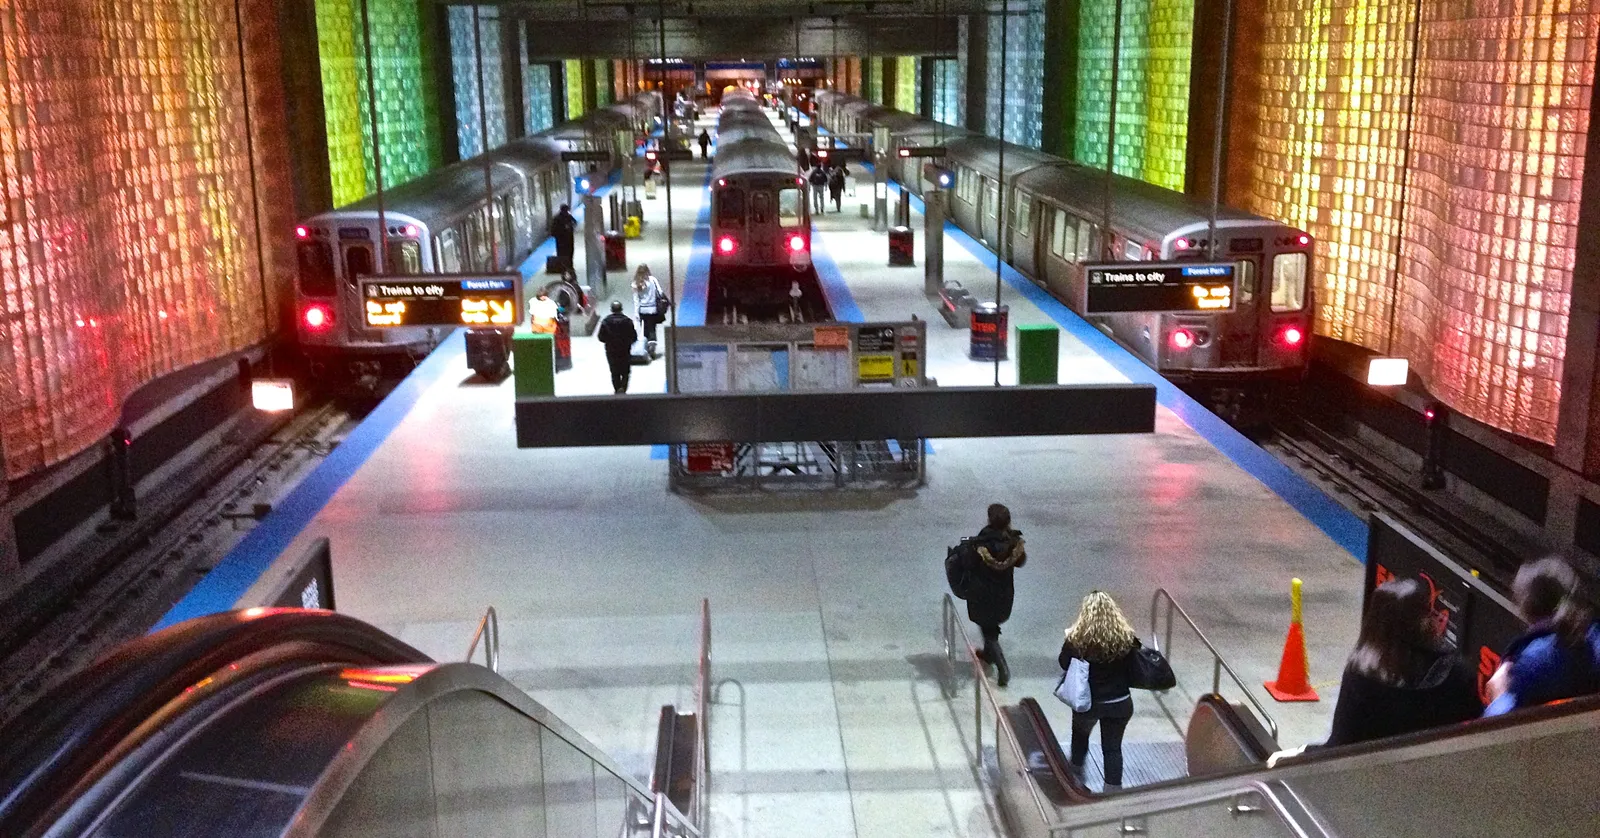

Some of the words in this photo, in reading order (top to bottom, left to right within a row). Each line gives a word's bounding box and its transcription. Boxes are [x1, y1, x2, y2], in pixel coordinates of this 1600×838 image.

[1188, 267, 1209, 275] Forest
[1104, 273, 1134, 282] Trains
[1136, 273, 1146, 281] to
[1147, 272, 1165, 283] city
[467, 281, 488, 289] Forest
[489, 280, 505, 288] Park
[380, 285, 412, 297] Trains
[414, 285, 424, 295] to
[426, 285, 444, 297] city
